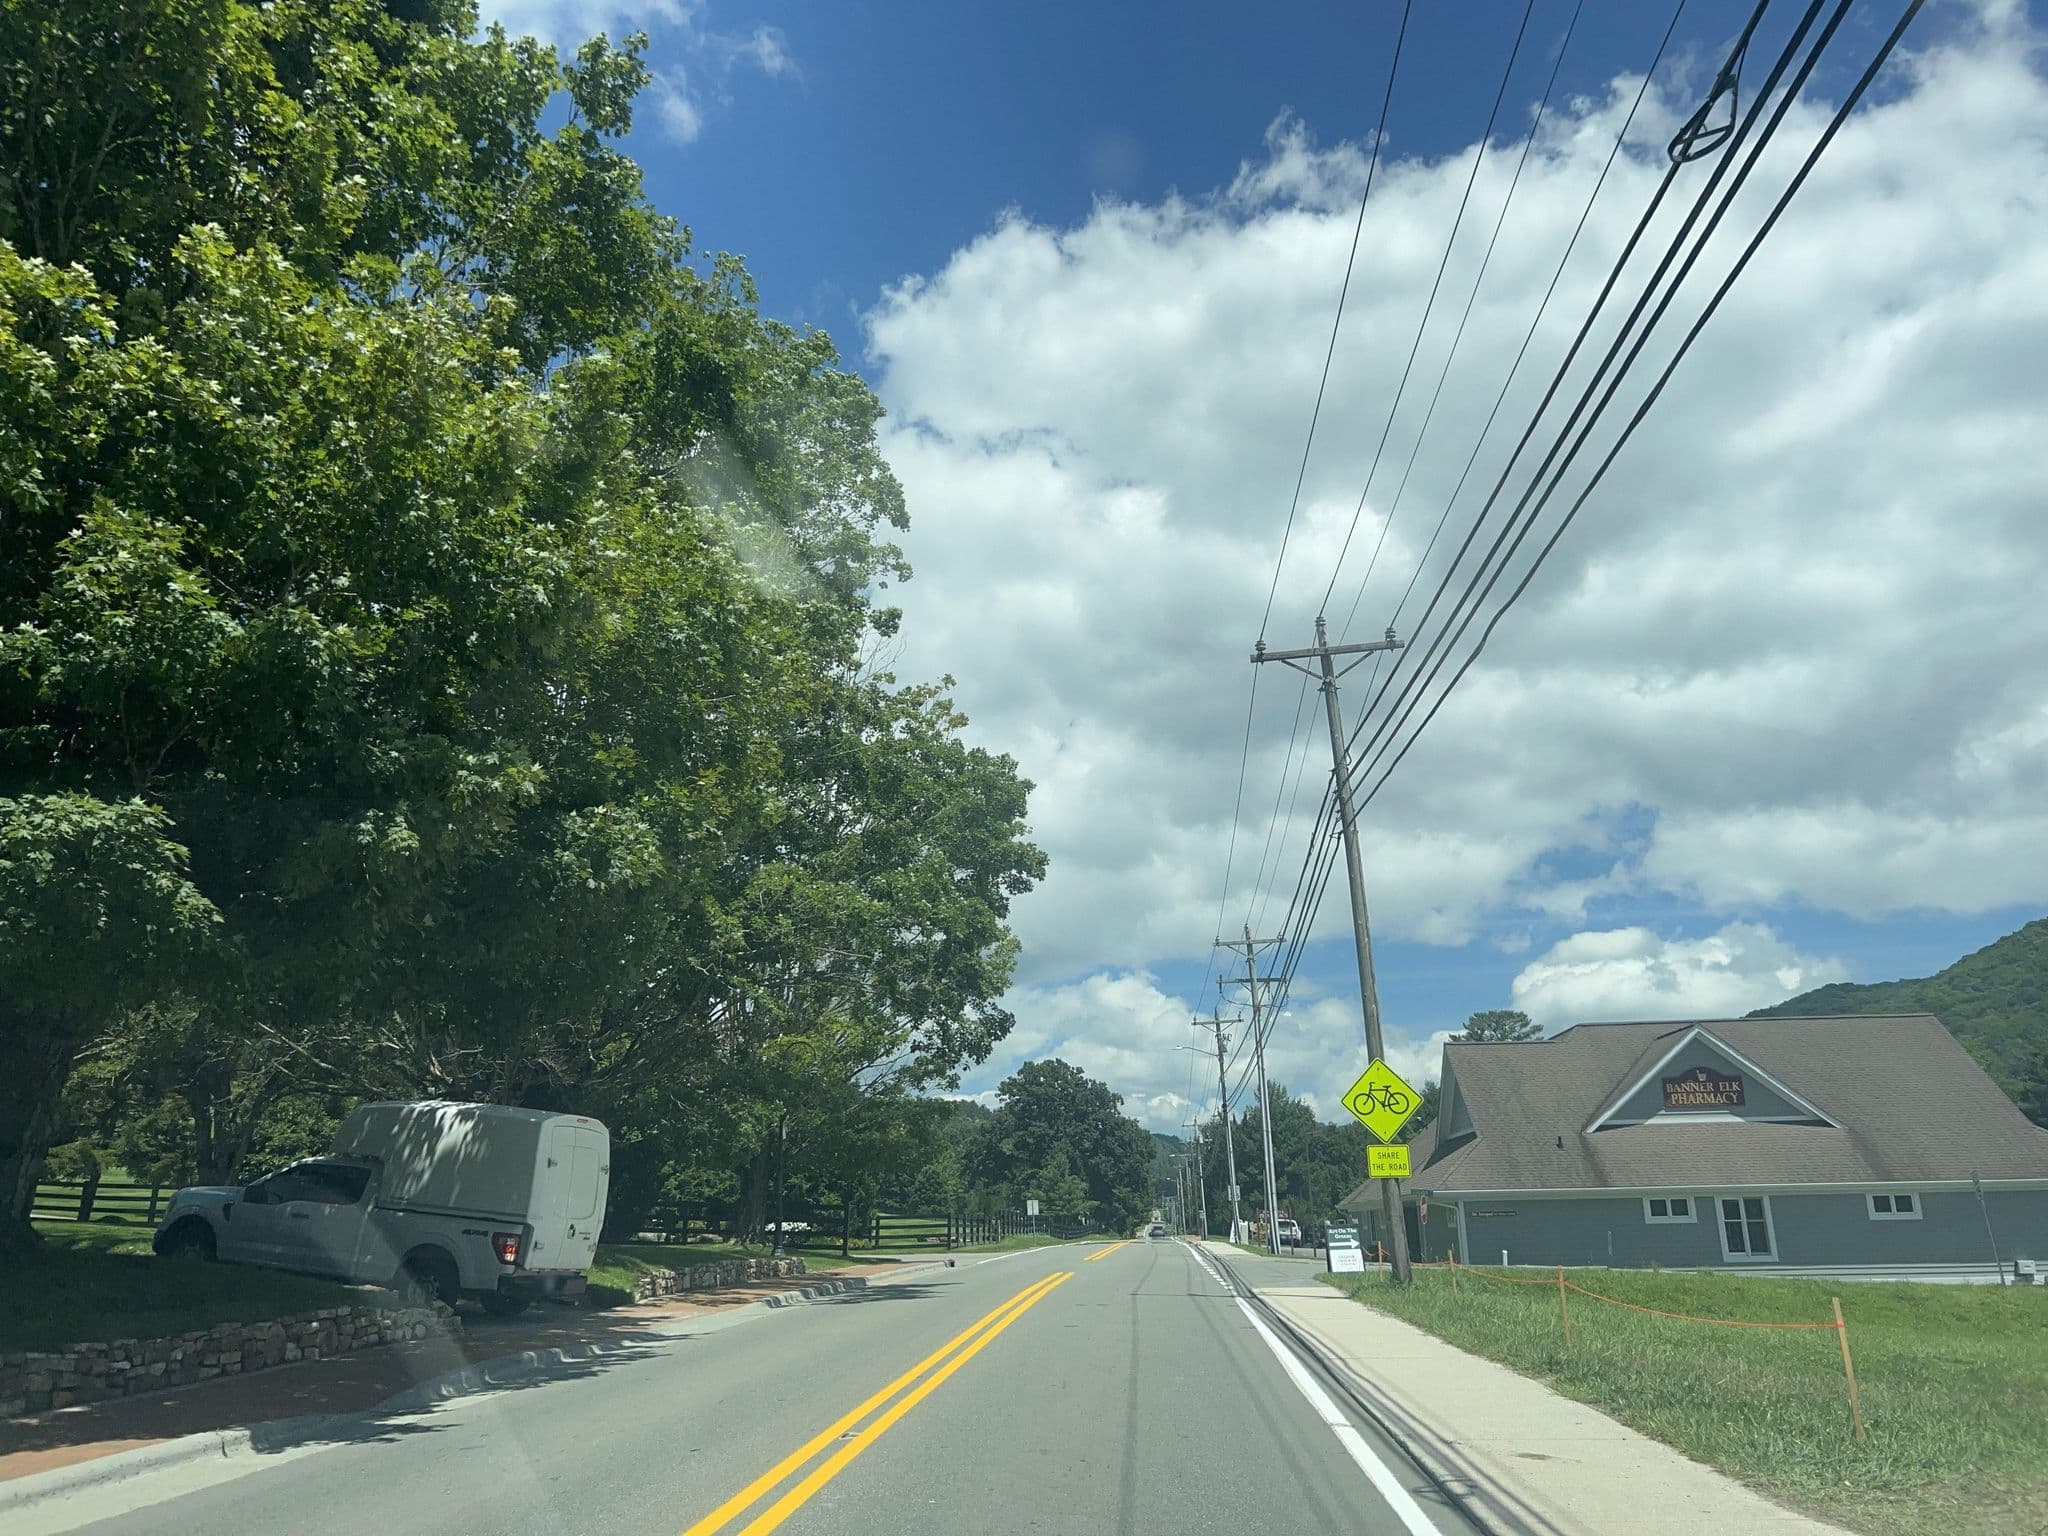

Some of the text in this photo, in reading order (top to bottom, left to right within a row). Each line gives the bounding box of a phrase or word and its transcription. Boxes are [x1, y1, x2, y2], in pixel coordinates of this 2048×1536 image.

[1666, 1081, 1741, 1092] BANNER ELK
[1671, 1092, 1738, 1104] PHARMACY
[1377, 1151, 1400, 1160] SHARE
[1372, 1163, 1408, 1171] THE ROAD
